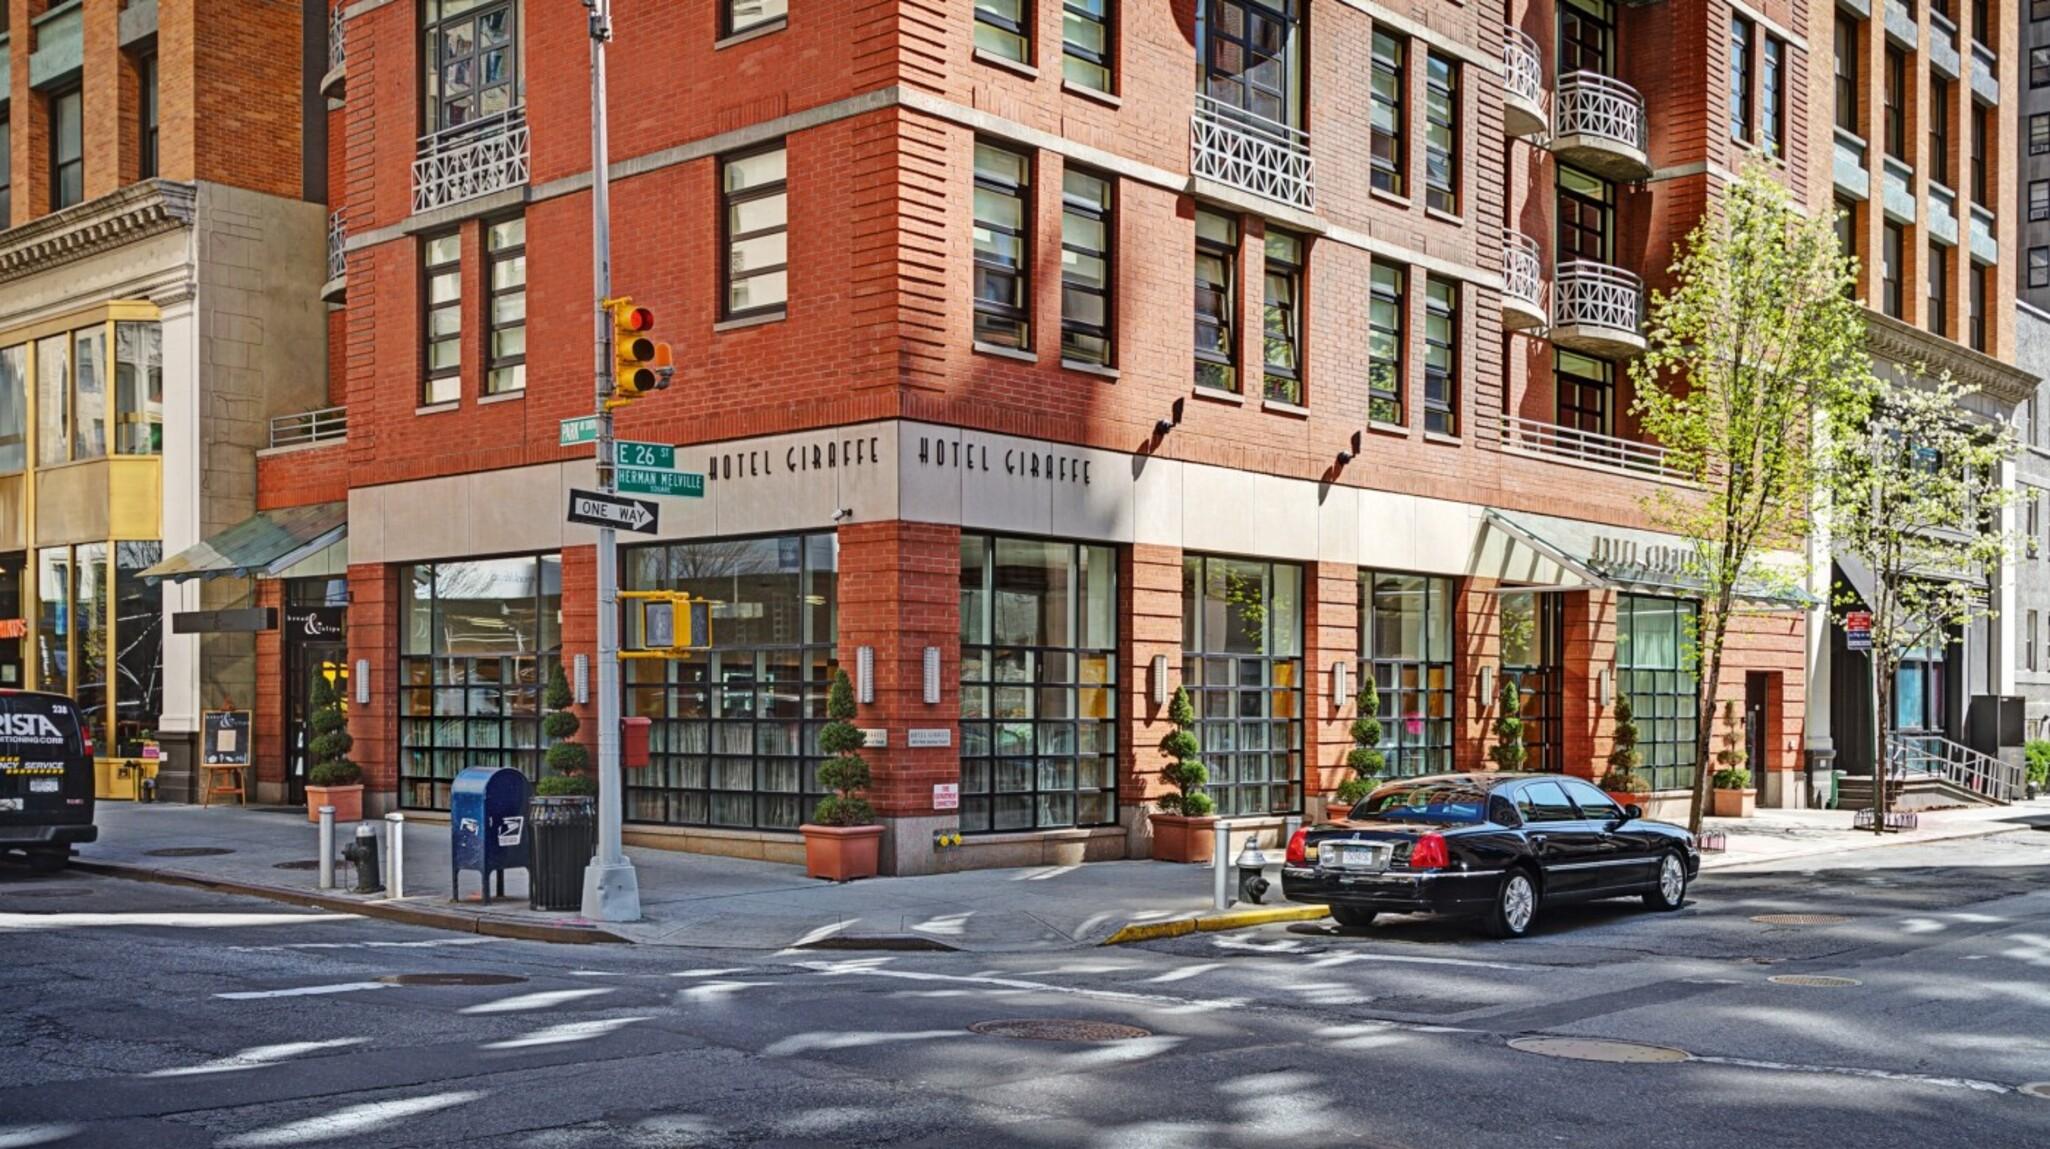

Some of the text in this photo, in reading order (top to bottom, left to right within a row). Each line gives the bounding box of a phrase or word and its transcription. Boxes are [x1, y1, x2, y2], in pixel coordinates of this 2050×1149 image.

[561, 421, 579, 442] PARK
[620, 444, 670, 465] E 26 ST
[709, 437, 878, 480] HOTEL GIRAFFE
[918, 437, 1091, 484] HOTEL GIRAFFE
[618, 471, 701, 489] HERMAN MELVILLE
[650, 485, 672, 494] SQUARE
[582, 501, 646, 523] ONE WAY
[304, 612, 321, 635] &
